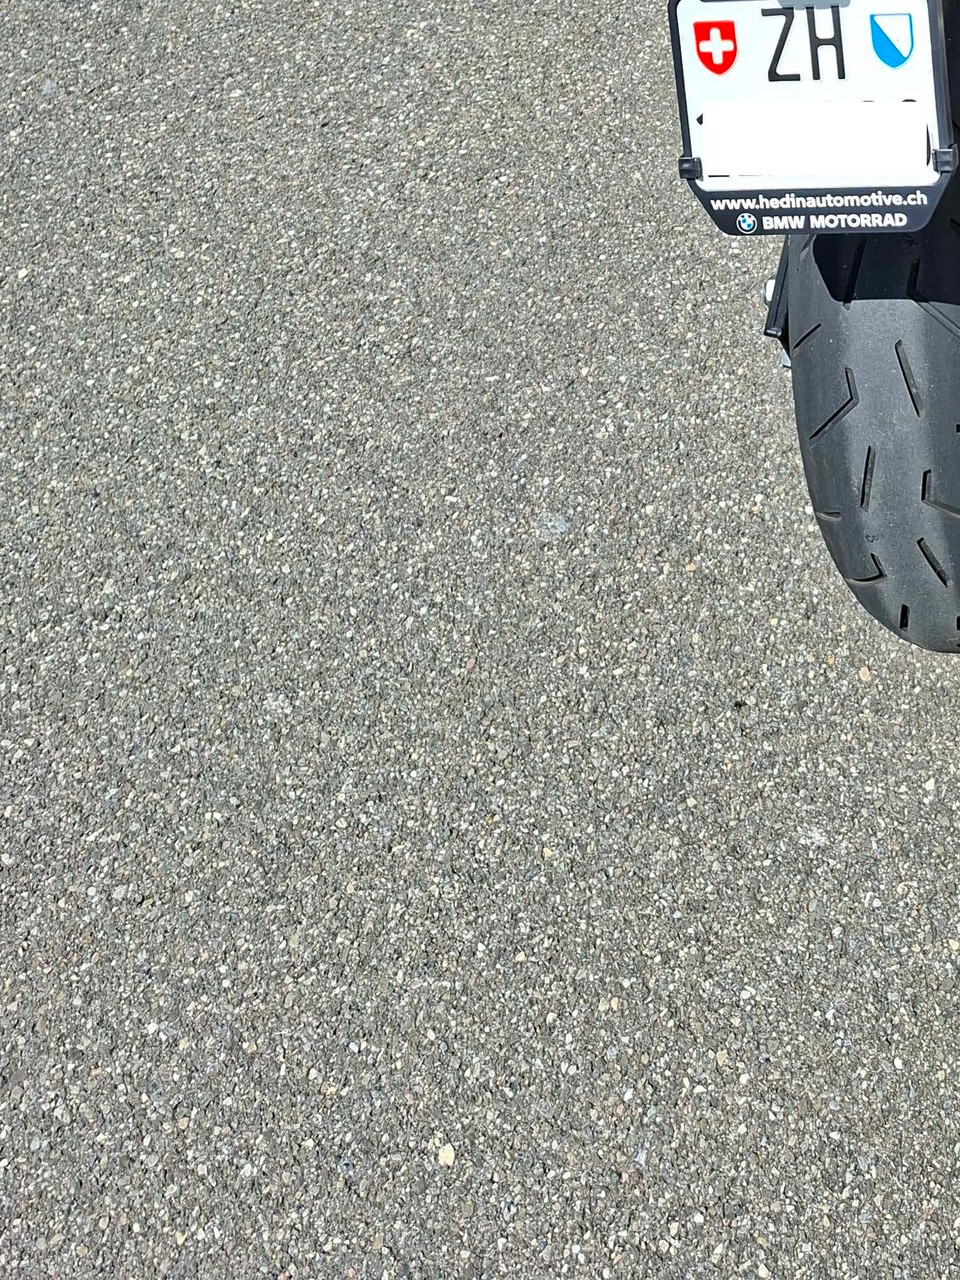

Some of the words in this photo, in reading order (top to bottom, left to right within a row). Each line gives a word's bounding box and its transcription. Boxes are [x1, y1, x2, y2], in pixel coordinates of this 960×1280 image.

[761, 5, 846, 82] ZH
[710, 190, 928, 210] www.hedinautomotive.ch
[762, 215, 805, 230] BMW
[810, 213, 908, 229] MOTORRAD
